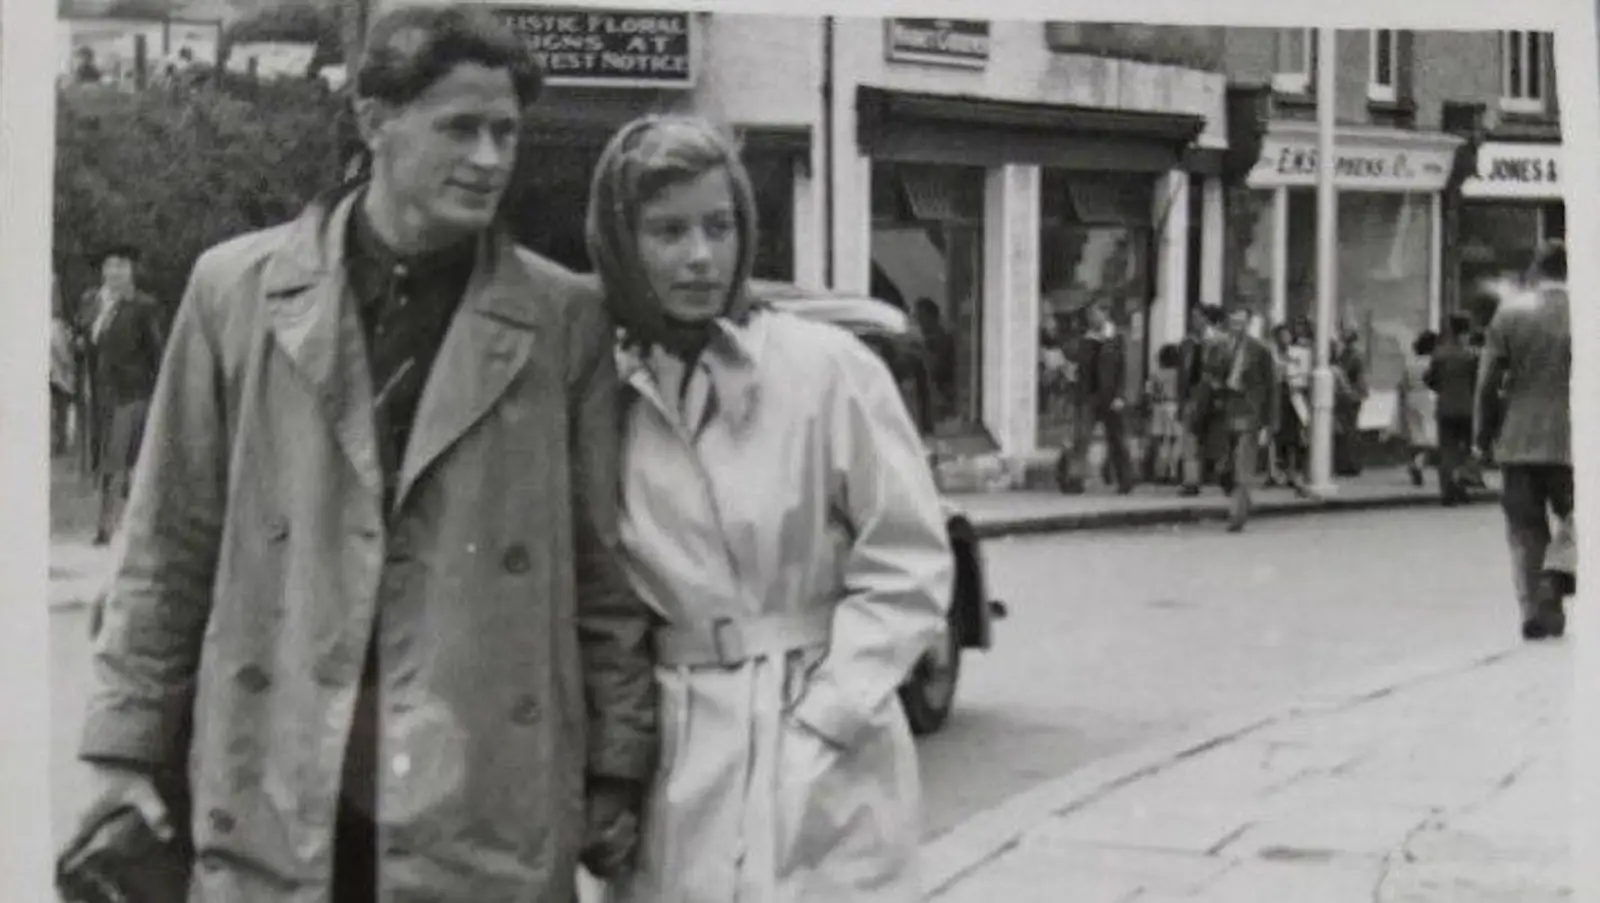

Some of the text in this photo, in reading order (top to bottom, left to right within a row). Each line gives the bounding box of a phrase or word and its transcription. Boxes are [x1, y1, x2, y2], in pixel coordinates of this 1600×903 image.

[588, 16, 686, 33] FLORAL
[626, 36, 668, 52] AT
[601, 53, 690, 71] NOTICE
[1489, 157, 1543, 182] JONES
